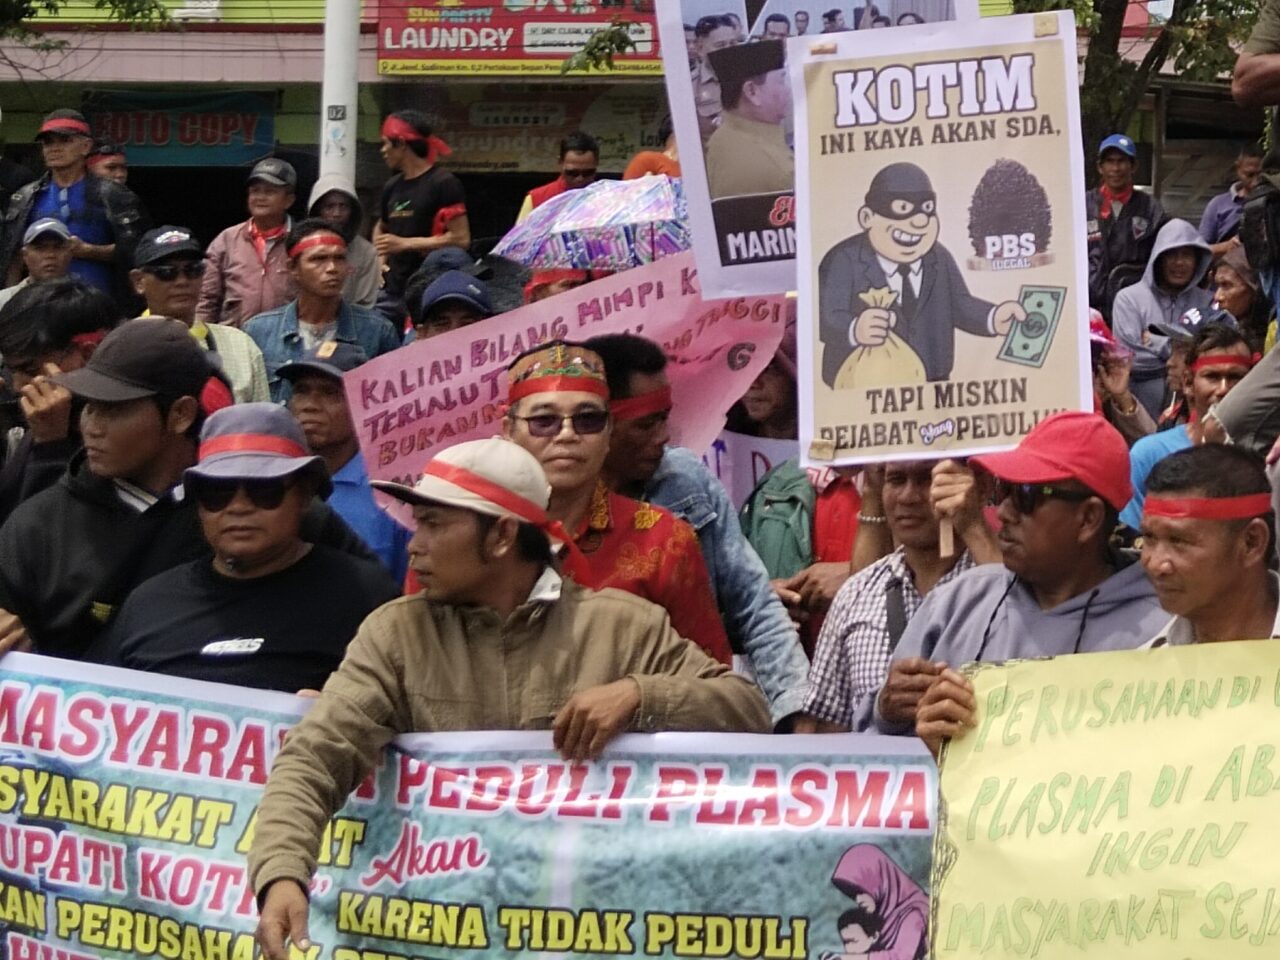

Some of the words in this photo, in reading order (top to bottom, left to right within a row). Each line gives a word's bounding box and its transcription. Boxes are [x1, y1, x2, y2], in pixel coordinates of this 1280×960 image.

[384, 26, 514, 51] LAUNDRY
[833, 53, 1037, 128] KOTIM
[99, 111, 171, 146] FOTO
[178, 111, 259, 146] COPY
[820, 131, 855, 155] INI
[864, 125, 924, 151] KAYA
[931, 119, 996, 144] AKAN
[1006, 114, 1062, 139] SDA,
[985, 233, 1036, 259] PBS
[361, 355, 462, 410] KALIAN
[470, 315, 569, 370] BILANG
[577, 279, 664, 328] MIMPI
[362, 382, 479, 443] TERLALU
[866, 385, 924, 415] TAPI
[935, 377, 1028, 410] MISKIN
[820, 419, 919, 450] PEJABAT
[919, 417, 957, 446] Yang
[973, 676, 1223, 753] PERUSAHAAN
[1227, 673, 1264, 709] DI
[398, 753, 633, 820] PEDULI
[649, 765, 930, 830] PLASMA
[967, 770, 1133, 843] PLASMA
[1149, 764, 1194, 809] DI
[361, 821, 486, 886] Akan
[1086, 820, 1249, 879] INGIN
[337, 891, 490, 947] KARENA
[500, 906, 636, 954] TIDAK
[644, 912, 810, 960] PEDULI
[942, 888, 1198, 960] MASYARAKAT
